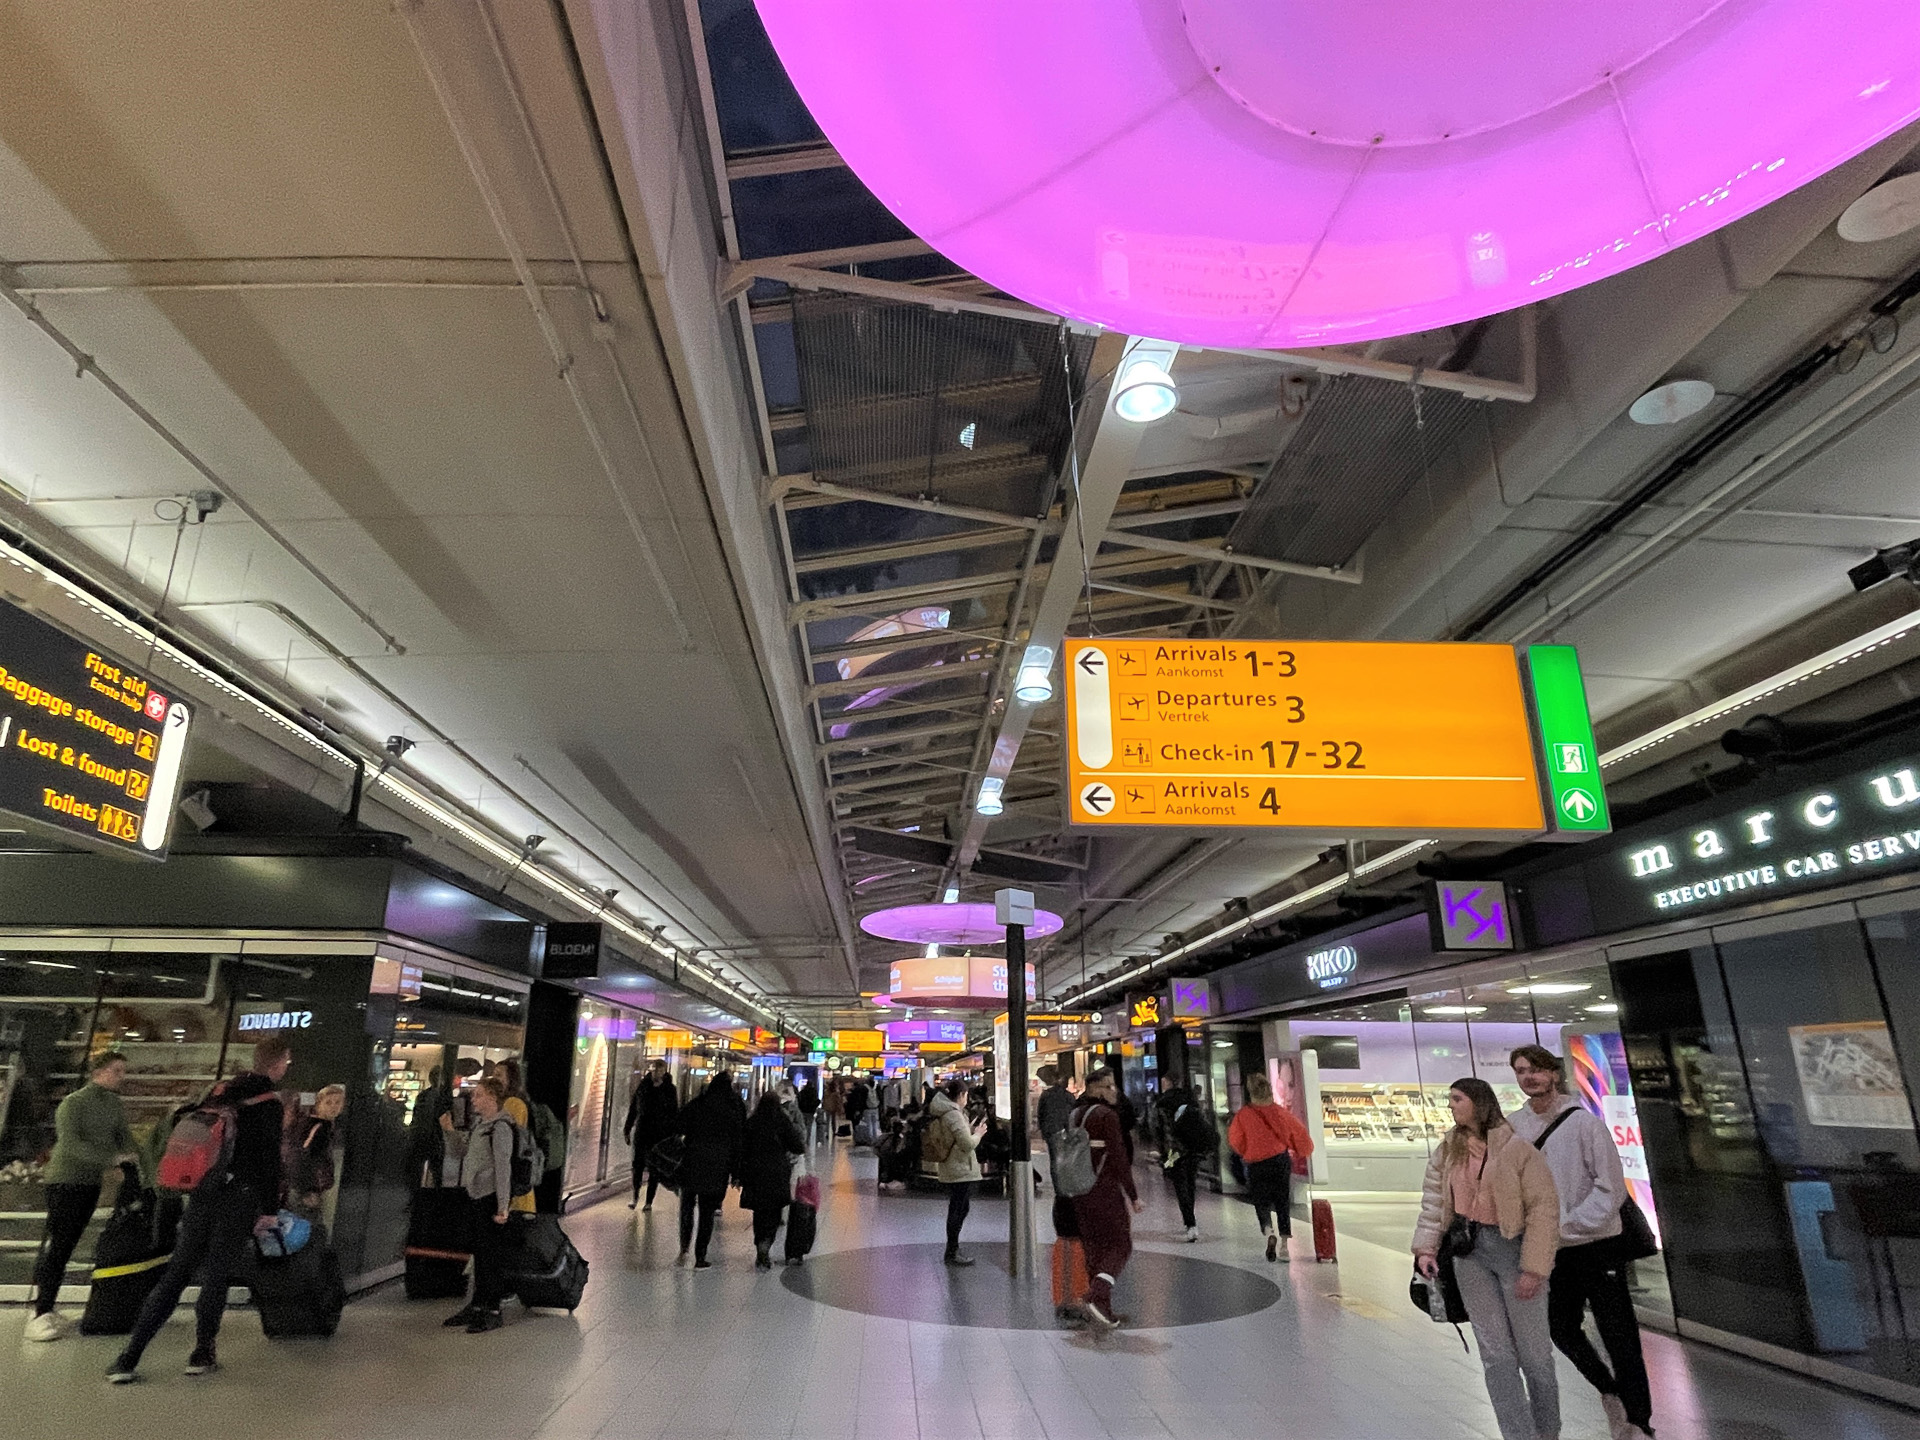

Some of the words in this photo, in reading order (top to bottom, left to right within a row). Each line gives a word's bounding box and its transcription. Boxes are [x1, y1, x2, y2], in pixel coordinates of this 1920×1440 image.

[85, 652, 121, 684] First
[122, 675, 147, 697] aid
[1155, 645, 1237, 662] Arrivals
[1244, 650, 1297, 677] 1-3
[1156, 666, 1224, 678] Aankomst
[121, 691, 142, 713] hulp
[1157, 690, 1277, 710] Departures
[1286, 695, 1305, 723] 3
[1158, 711, 1210, 722] Vertrek
[75, 707, 135, 745] storage
[17, 729, 58, 760] Lost
[61, 747, 74, 766] &
[79, 753, 126, 787] found
[1161, 743, 1254, 761] Check-in
[1260, 740, 1366, 769] 17-32
[43, 787, 98, 823] Toilets
[1164, 781, 1250, 798] Arrivals
[1259, 787, 1281, 815] 4
[1165, 803, 1236, 816] Aankomst
[1654, 865, 1777, 909] EXECUTIVE
[1784, 852, 1839, 878] CAR
[1307, 946, 1357, 980] KIKO
